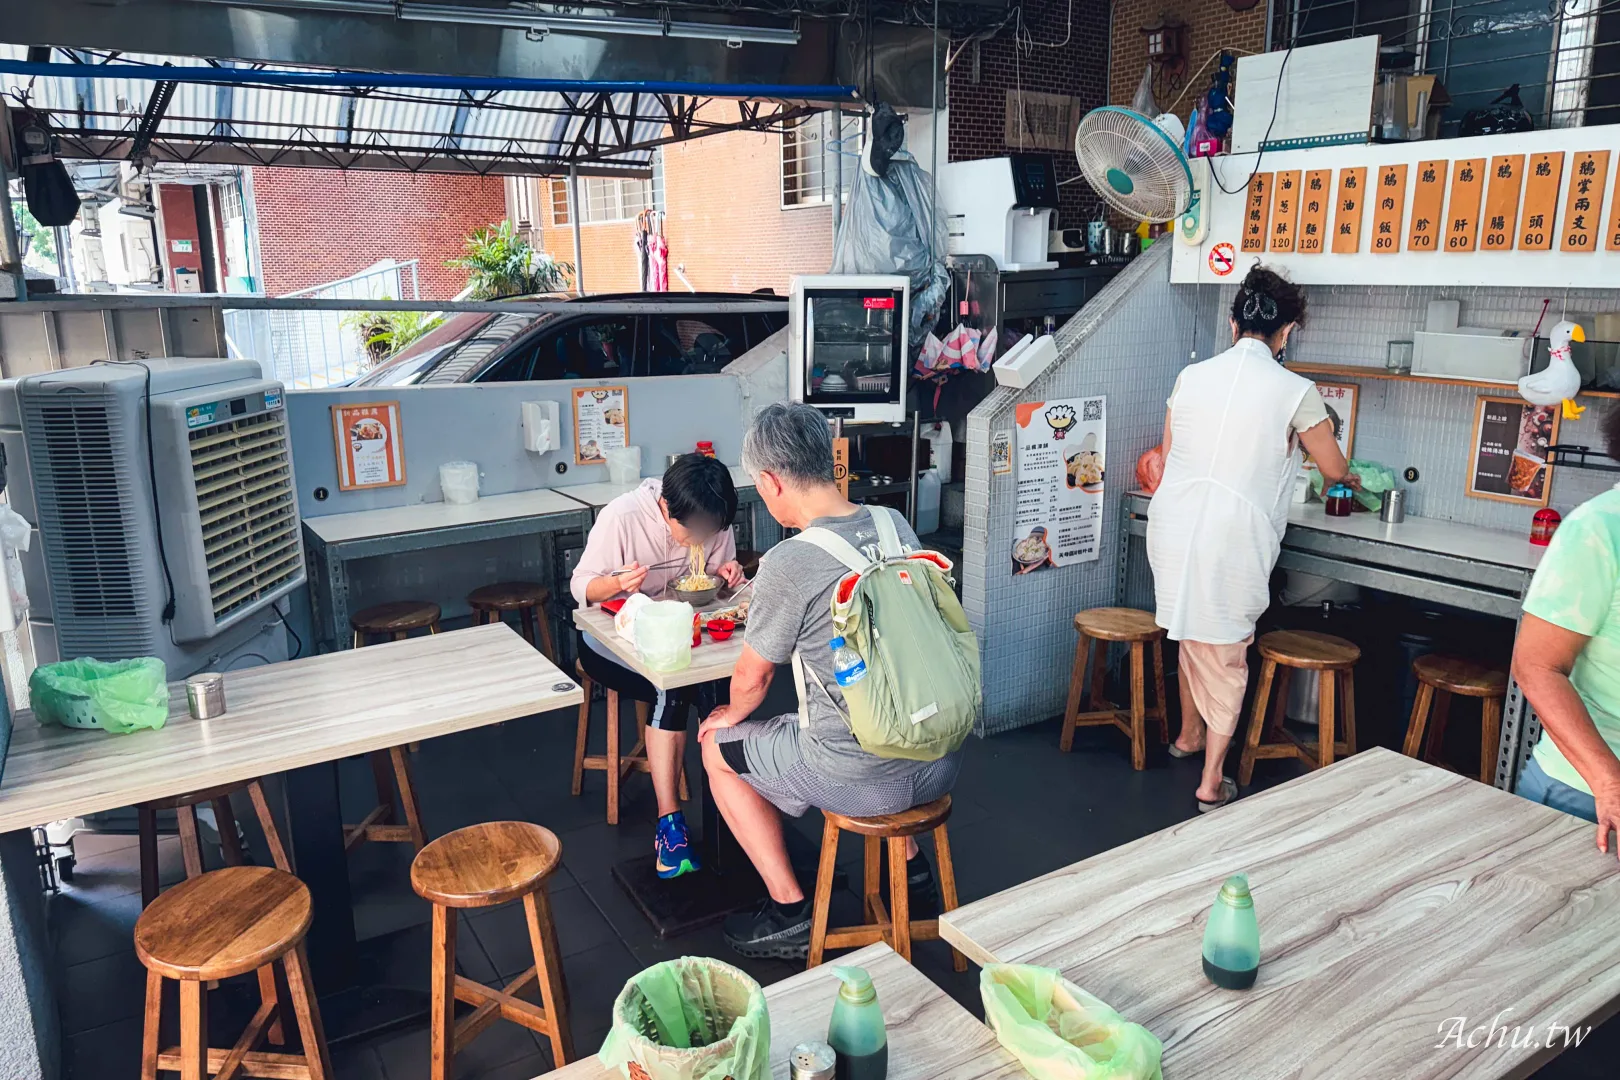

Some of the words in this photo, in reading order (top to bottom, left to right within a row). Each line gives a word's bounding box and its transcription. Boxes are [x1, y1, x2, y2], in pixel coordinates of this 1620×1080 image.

[1248, 180, 1264, 235] 清河鵝油
[1305, 177, 1322, 236] 鵝肉麵
[1340, 175, 1357, 235] 鵝油飯
[1379, 172, 1397, 234] 鵝肉飯
[1243, 238, 1260, 248] 250
[1272, 238, 1290, 248] 120
[1300, 239, 1319, 249] 120
[1376, 237, 1392, 248] 80
[1413, 235, 1430, 246] 70
[1449, 236, 1468, 248] 60
[1486, 234, 1505, 245] 60
[1524, 233, 1544, 245] 60
[1568, 234, 1588, 246] 60
